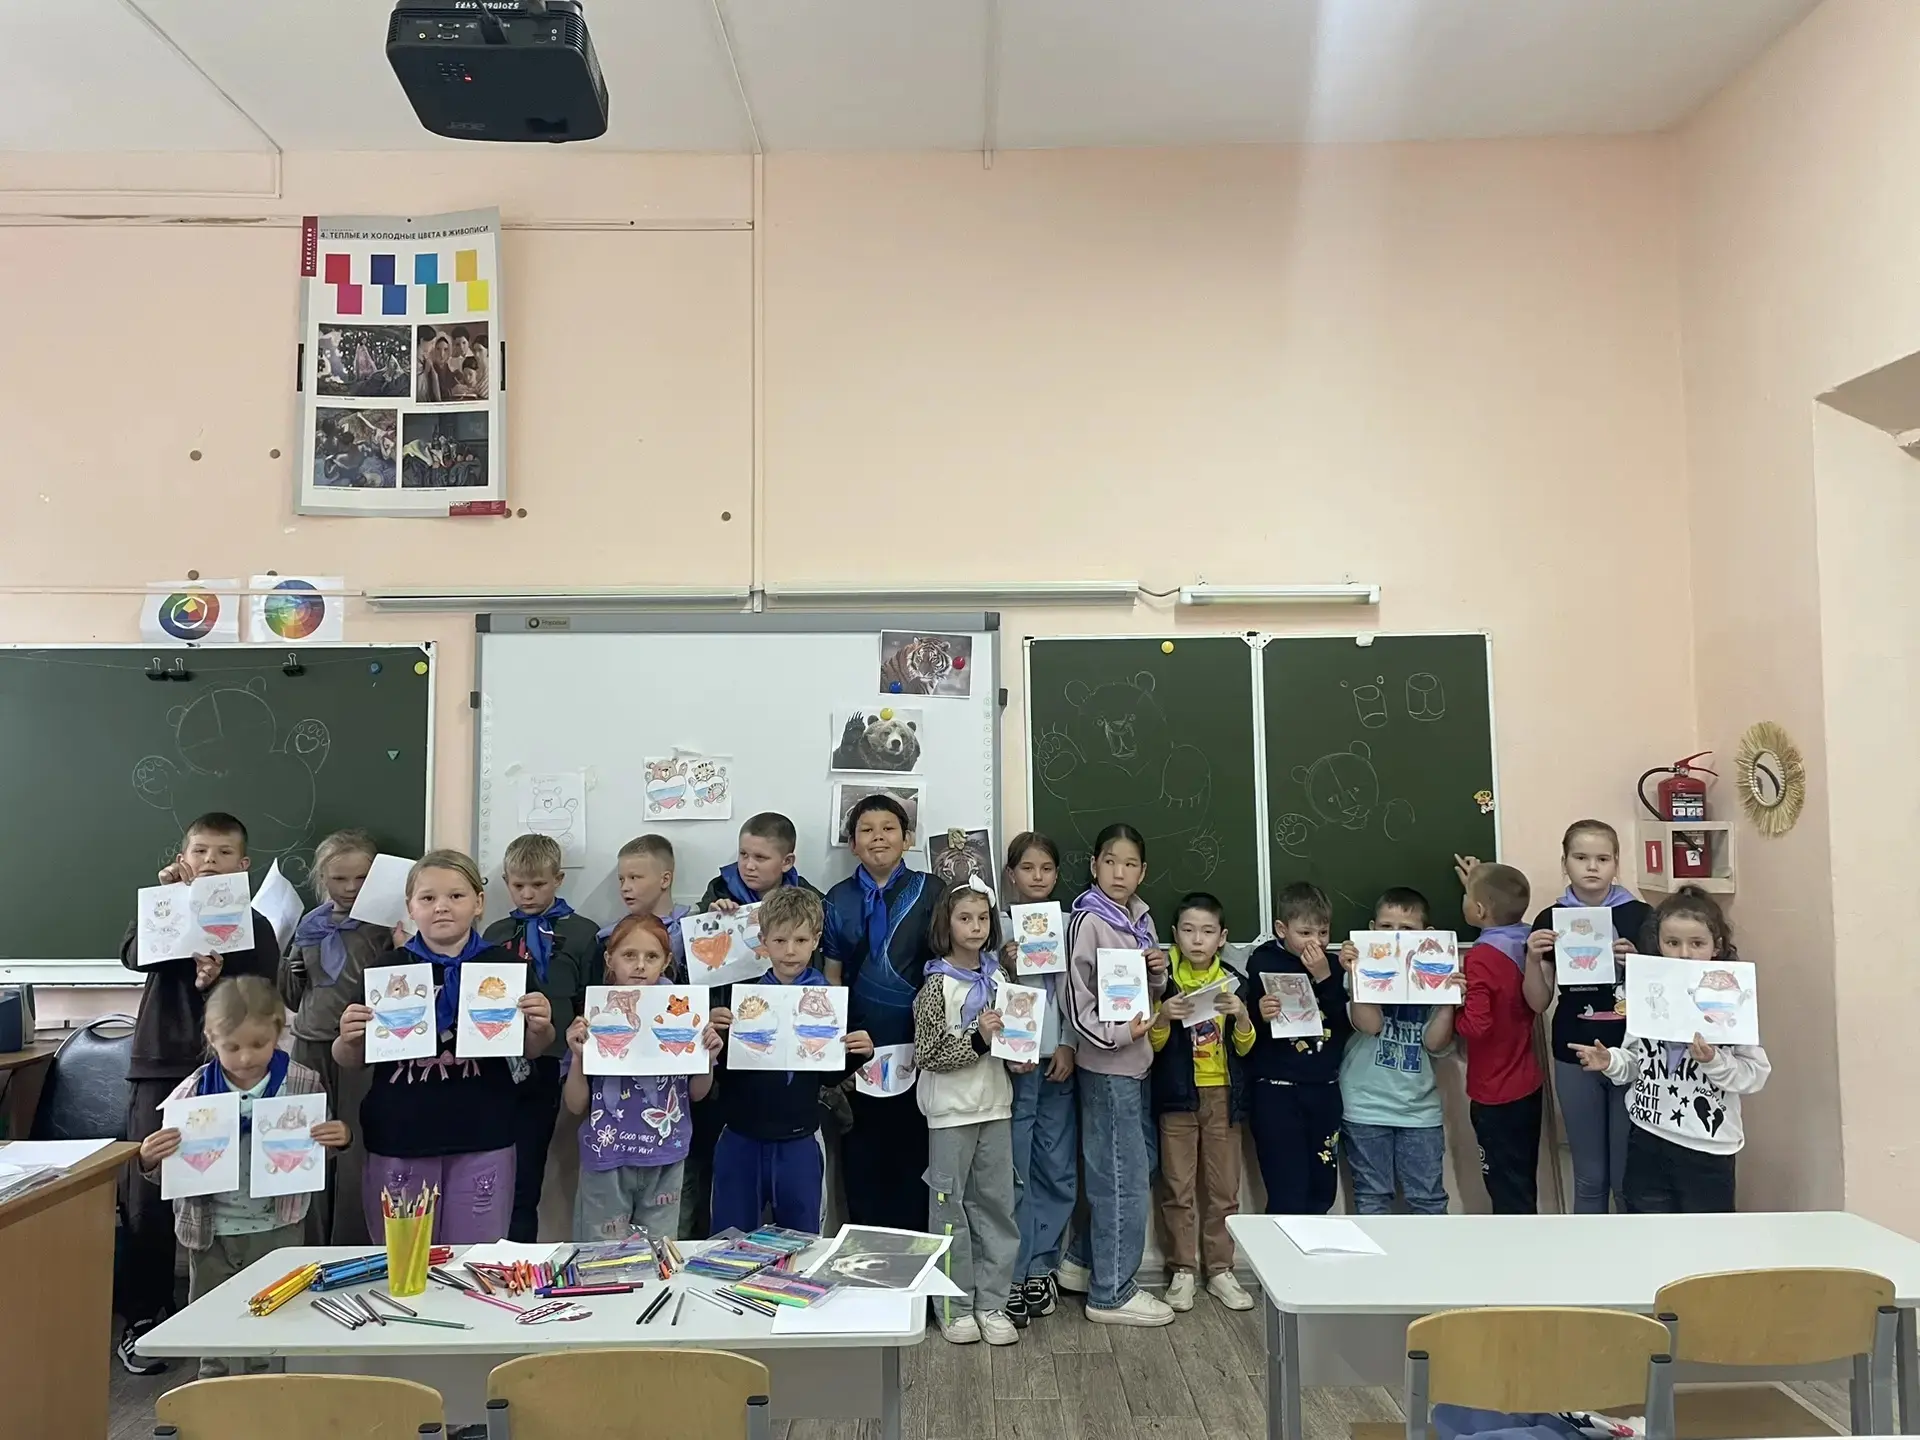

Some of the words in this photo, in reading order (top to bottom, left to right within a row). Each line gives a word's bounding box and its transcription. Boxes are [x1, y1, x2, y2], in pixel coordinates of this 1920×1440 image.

[371, 232, 416, 240] ХОЛОДНЫЕ
[418, 231, 440, 240] ЦВЕТА
[448, 225, 489, 236] ЖИВОПИСИ
[1691, 852, 1697, 861] 2
[619, 1131, 636, 1141] GOOD
[638, 1134, 657, 1143] VIBES!
[613, 1143, 626, 1152] IT'S
